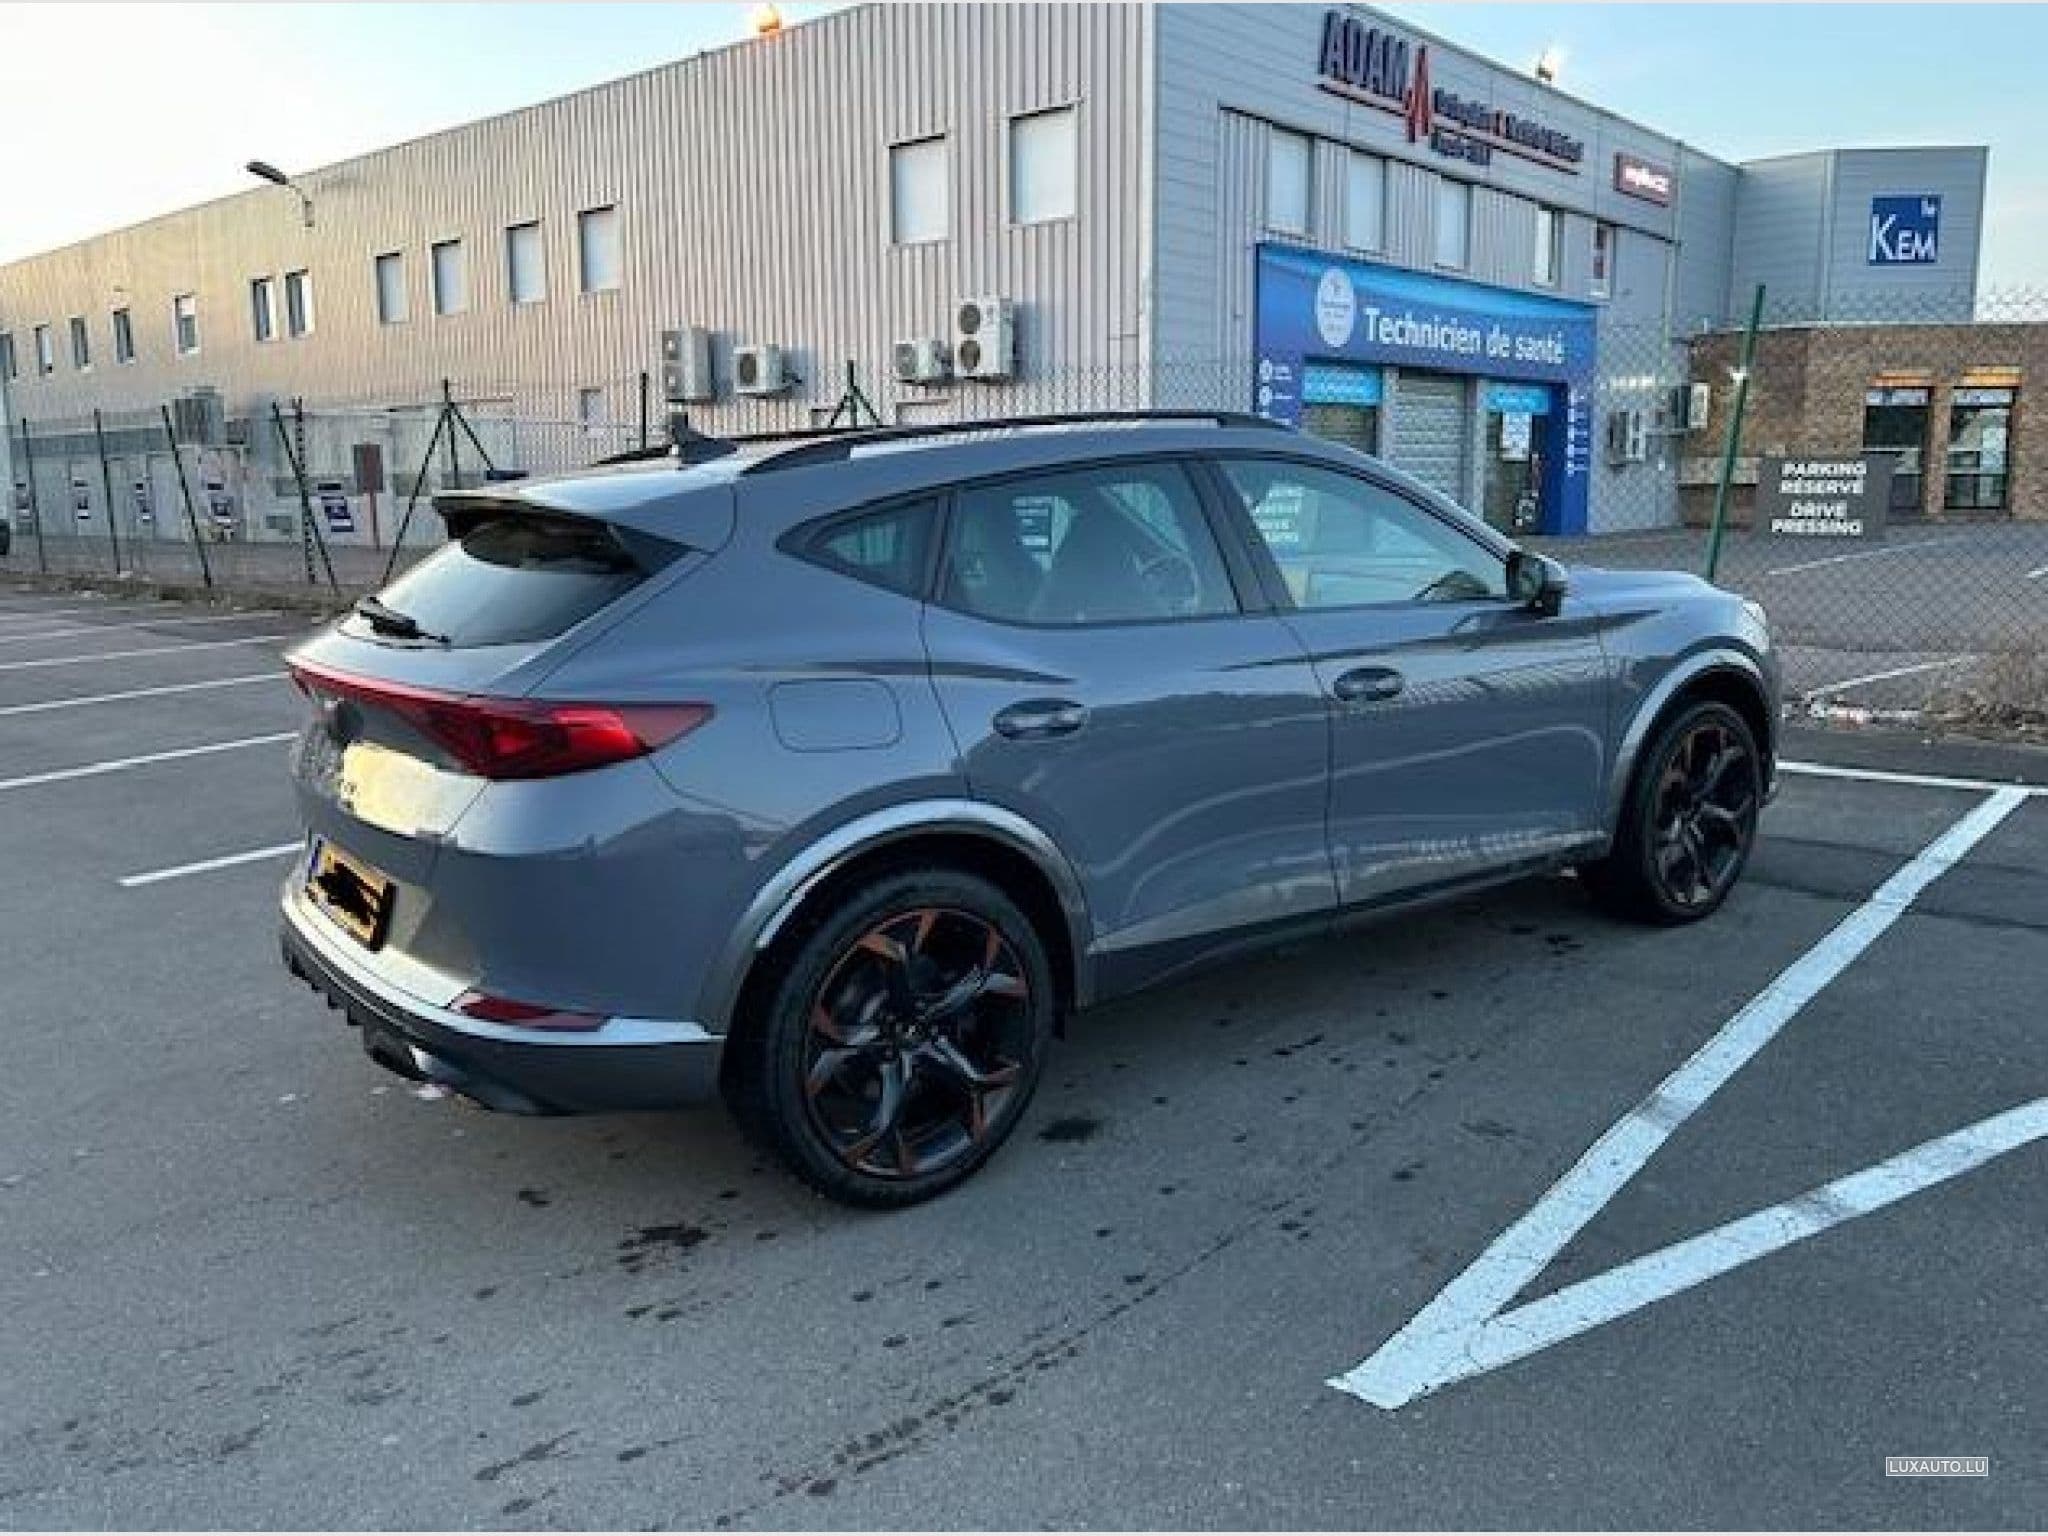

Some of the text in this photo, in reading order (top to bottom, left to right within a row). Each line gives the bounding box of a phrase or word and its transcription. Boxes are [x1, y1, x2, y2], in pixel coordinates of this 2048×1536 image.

[1318, 10, 1409, 101] ADAM
[1363, 307, 1481, 354] Technicien
[1486, 324, 1510, 358] de
[1515, 331, 1562, 363] santé
[1781, 462, 1866, 476] PARKING
[1790, 501, 1847, 517] DRIVE
[1770, 519, 1863, 536] PRESSING
